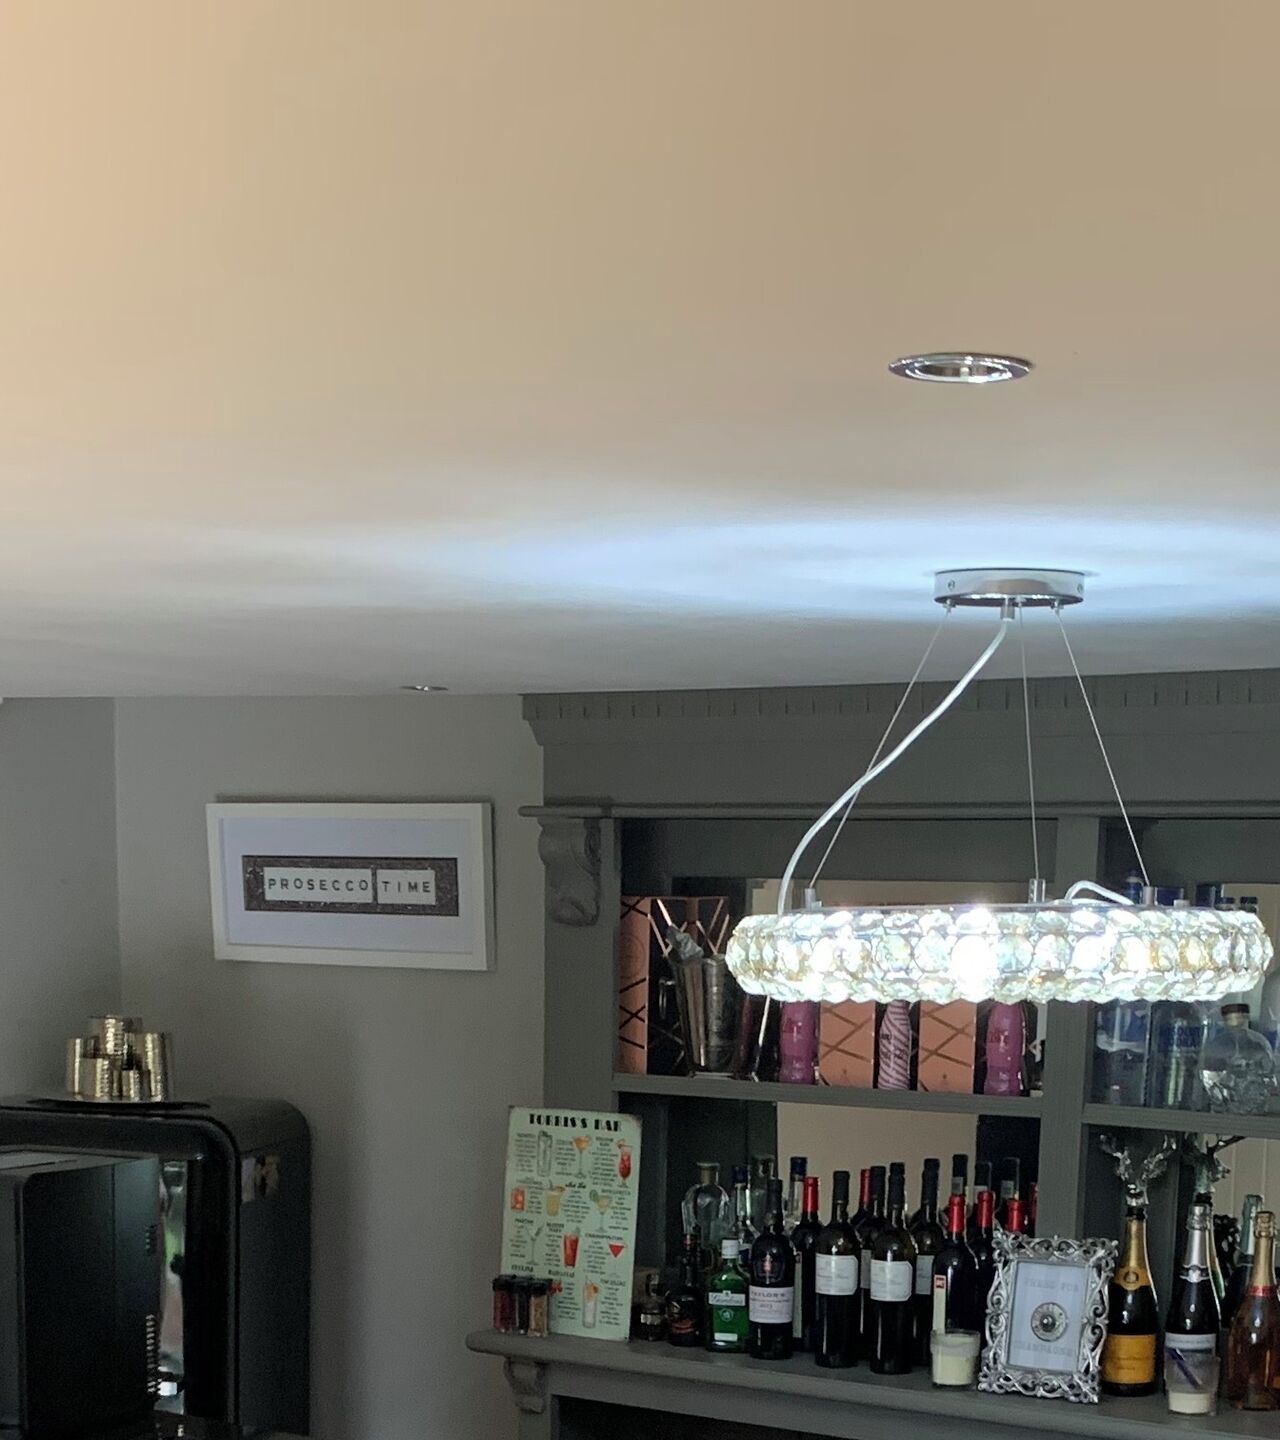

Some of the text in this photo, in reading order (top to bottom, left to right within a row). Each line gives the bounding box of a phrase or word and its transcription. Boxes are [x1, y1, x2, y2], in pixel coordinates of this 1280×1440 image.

[267, 876, 433, 894] PROSECCO TIME
[593, 1118, 622, 1133] BAR
